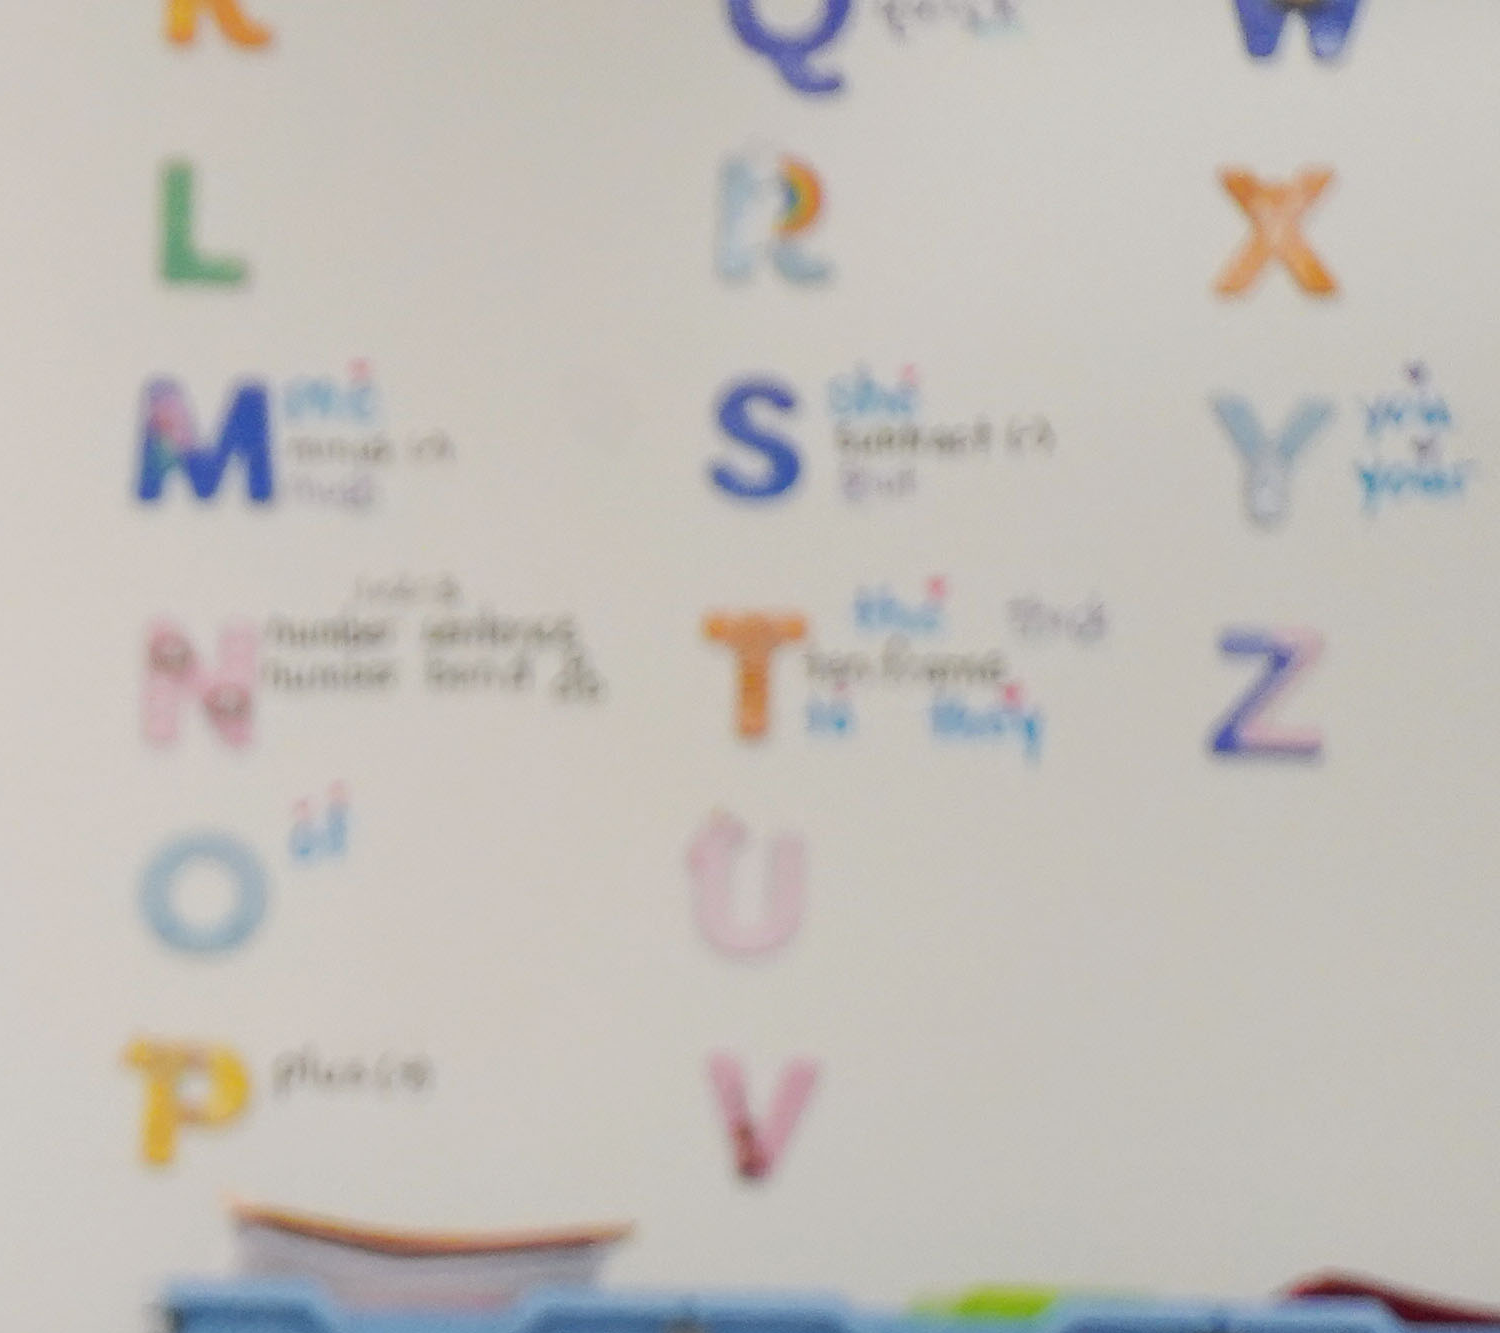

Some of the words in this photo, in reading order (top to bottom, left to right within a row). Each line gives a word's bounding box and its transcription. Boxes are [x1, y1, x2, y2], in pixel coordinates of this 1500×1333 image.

[725, 0, 853, 97] Q
[158, 161, 249, 289] L
[715, 155, 828, 285] R
[1216, 169, 1339, 301] X
[136, 380, 274, 506] M
[710, 380, 802, 502] S
[1210, 395, 1336, 528] Y
[145, 623, 257, 750] N
[703, 611, 808, 743] T
[1207, 631, 1321, 762] Z
[138, 831, 270, 957] O
[686, 810, 806, 958] U
[125, 1038, 252, 1168] P
[708, 1053, 820, 1183] V
